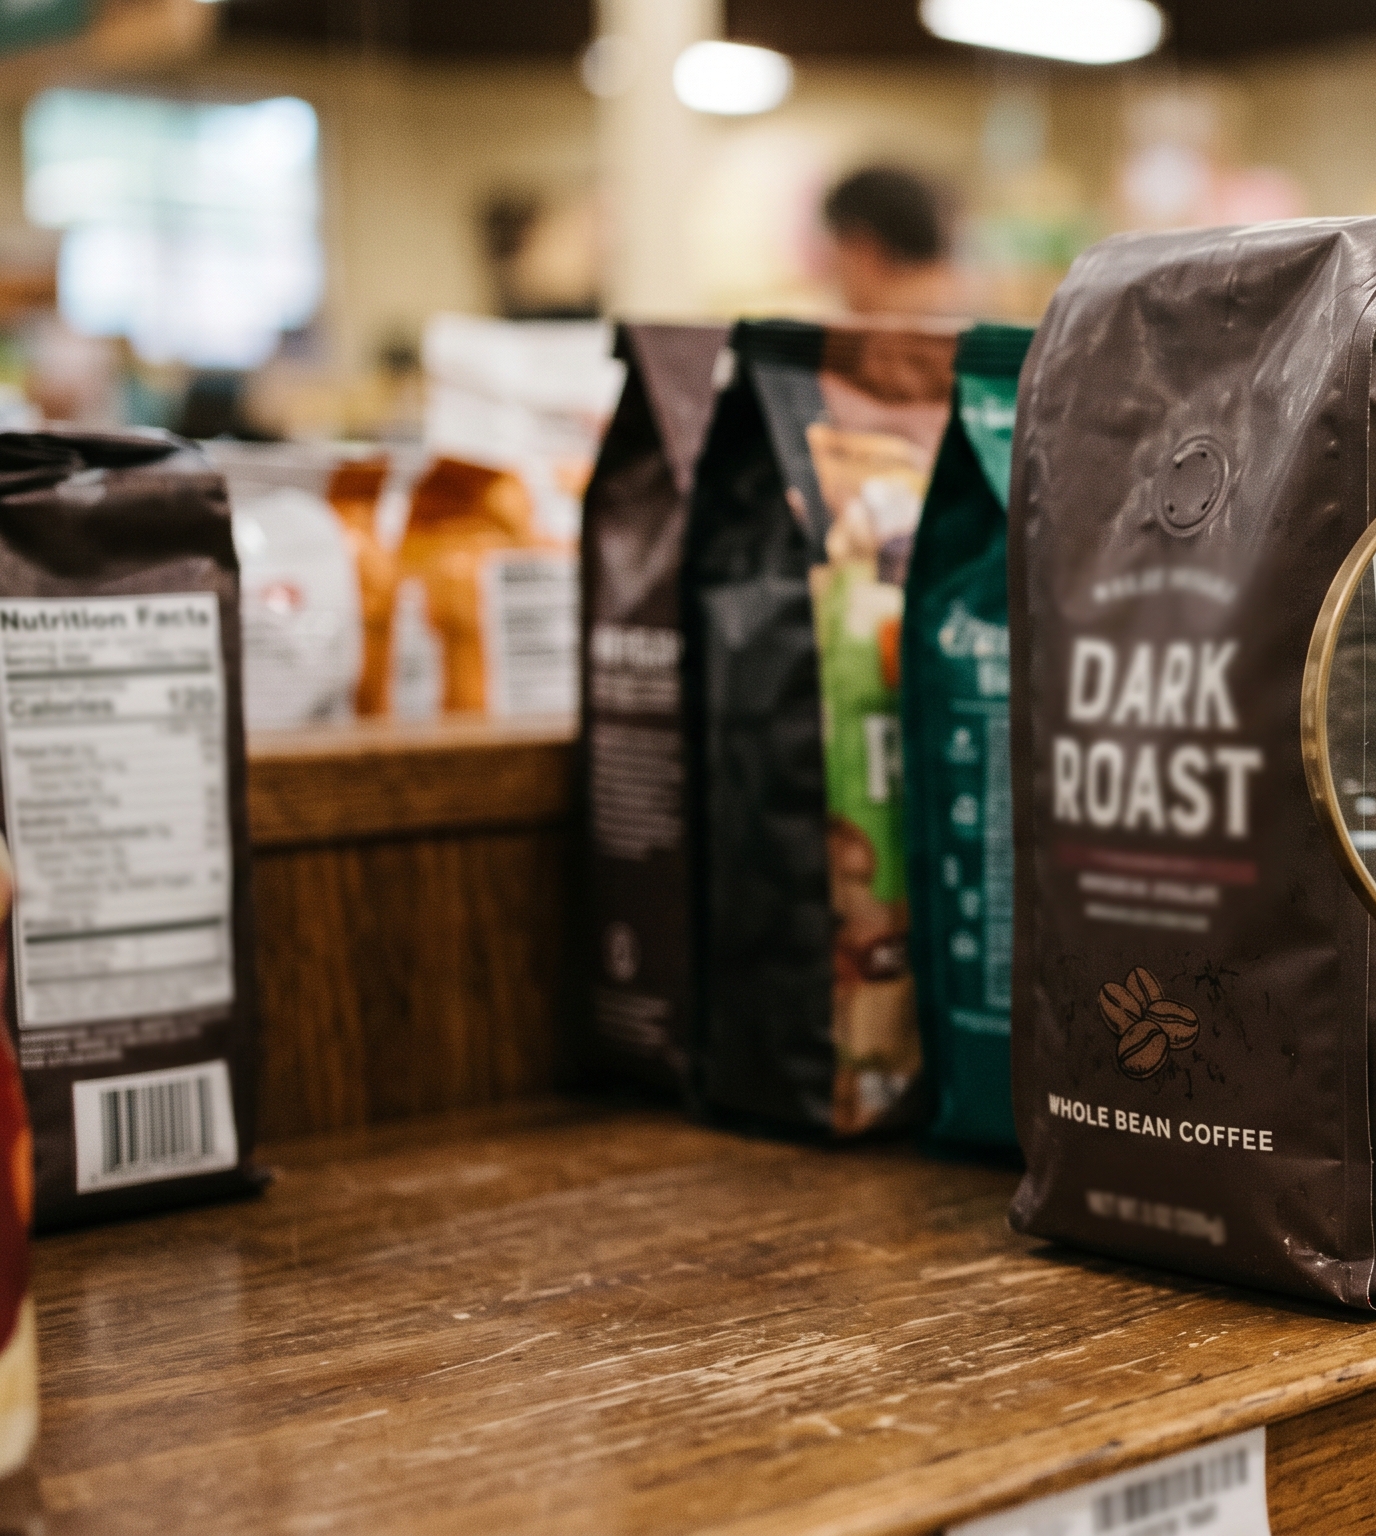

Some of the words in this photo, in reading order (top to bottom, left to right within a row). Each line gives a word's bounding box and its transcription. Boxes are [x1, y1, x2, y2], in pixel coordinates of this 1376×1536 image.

[0, 608, 128, 632] Nutrition
[135, 605, 209, 629] Facts
[1067, 636, 1239, 731] DARK
[1052, 736, 1265, 839] ROAST
[1049, 1092, 1109, 1129] WHOLE
[1115, 1109, 1171, 1140] BEAN
[1178, 1120, 1274, 1152] COFFEE
